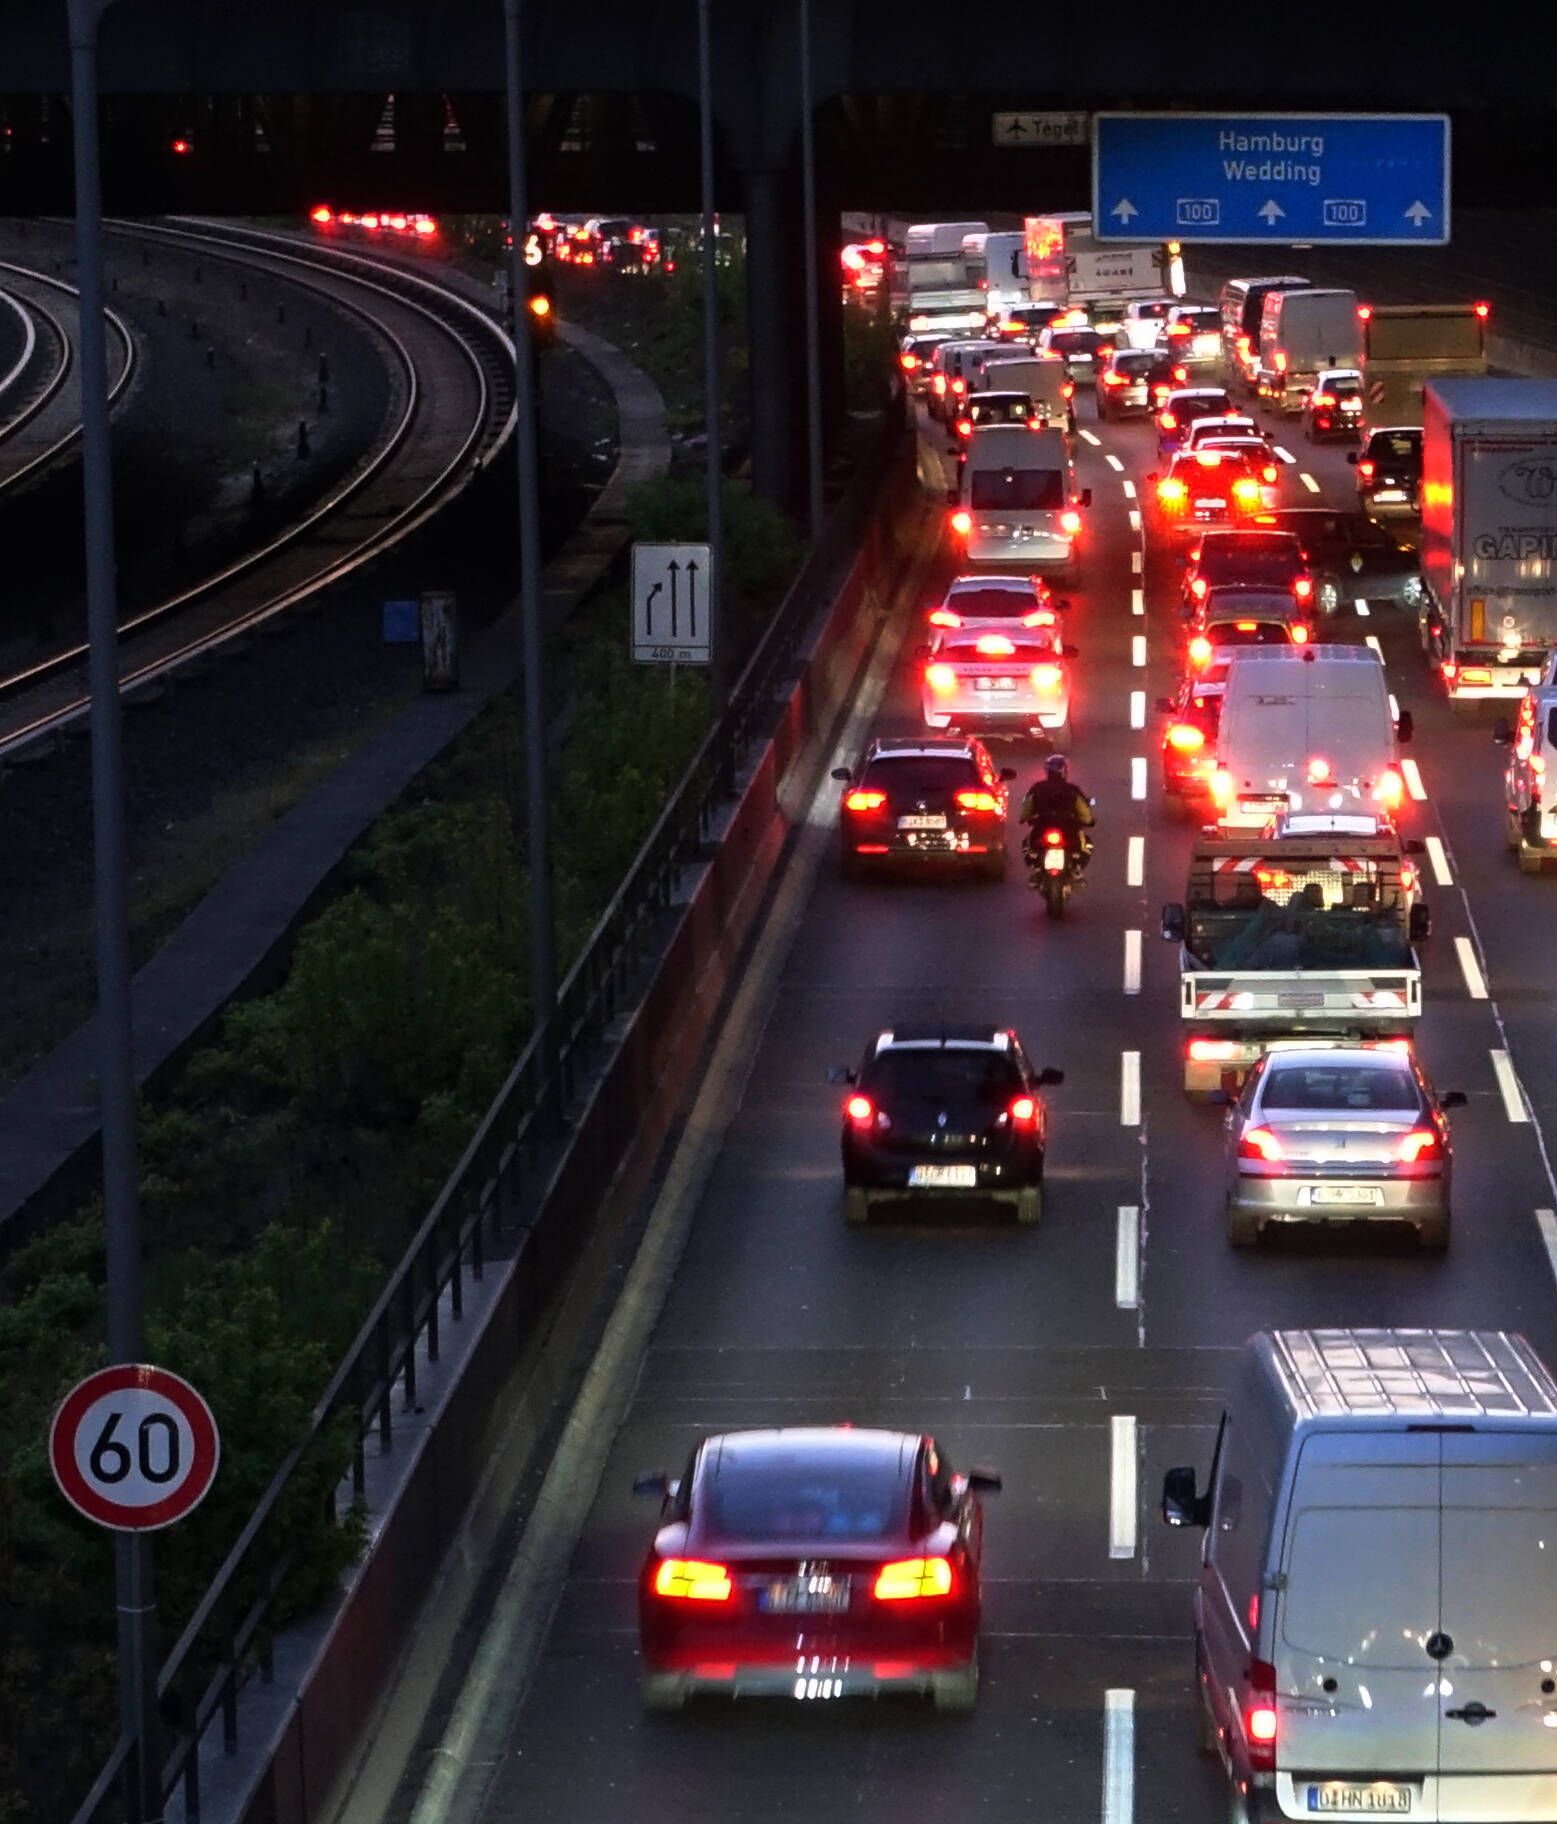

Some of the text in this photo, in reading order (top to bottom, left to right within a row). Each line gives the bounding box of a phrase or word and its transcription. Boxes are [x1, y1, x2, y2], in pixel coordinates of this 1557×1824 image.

[1032, 119, 1079, 139] Tegel
[1219, 131, 1324, 157] Hamburg
[1223, 160, 1321, 185] Wedding
[1184, 203, 1212, 220] 100
[1330, 204, 1359, 221] 100
[90, 1413, 180, 1484] 60
